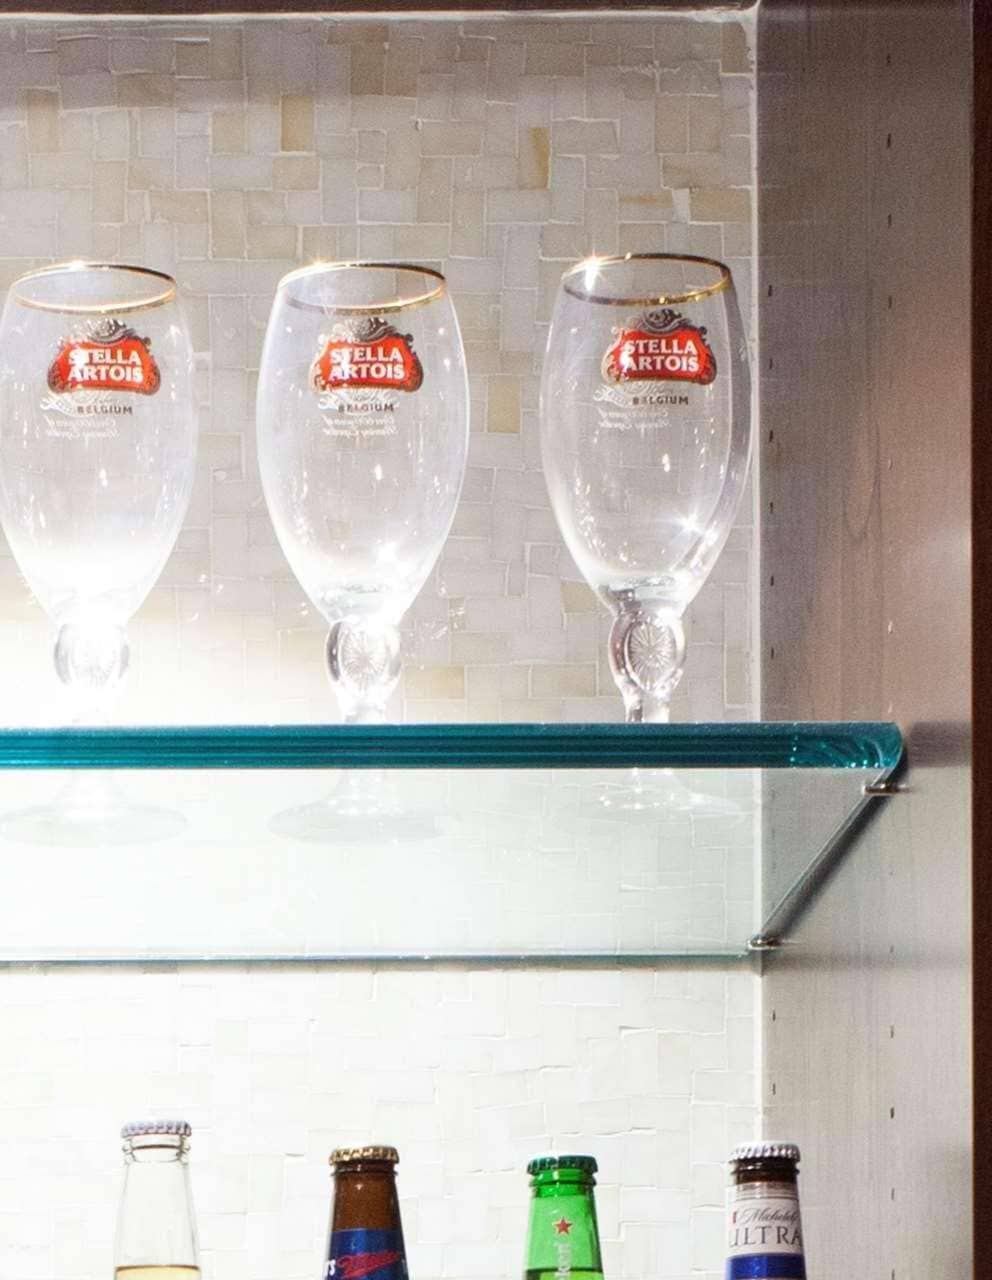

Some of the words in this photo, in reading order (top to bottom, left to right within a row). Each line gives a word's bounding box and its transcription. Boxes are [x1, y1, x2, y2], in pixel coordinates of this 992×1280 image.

[329, 347, 404, 362] STELLA
[622, 339, 698, 355] STELLA
[68, 348, 143, 365] STELLA
[622, 355, 700, 372] ARTOIS
[67, 365, 144, 383] ARTOIS
[328, 363, 406, 381] ARTOIS
[729, 1225, 802, 1248] ULTRA
